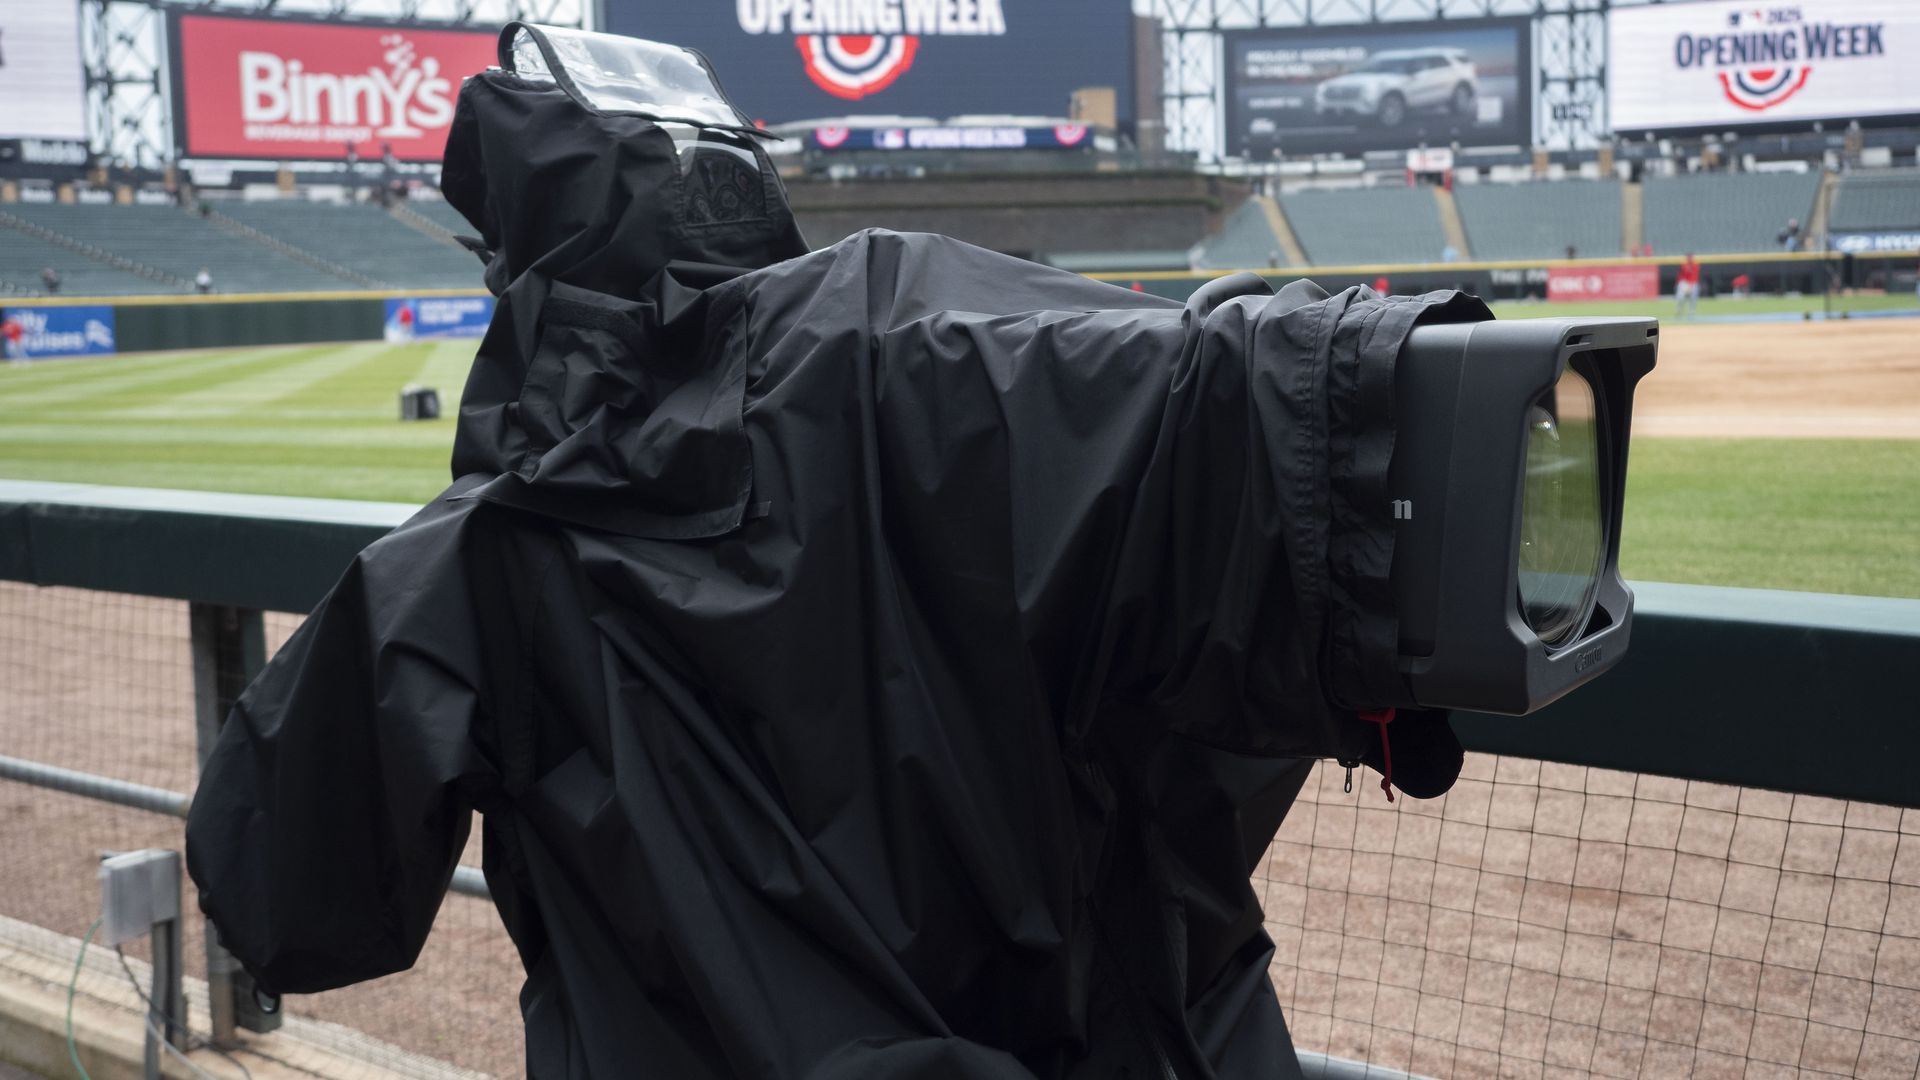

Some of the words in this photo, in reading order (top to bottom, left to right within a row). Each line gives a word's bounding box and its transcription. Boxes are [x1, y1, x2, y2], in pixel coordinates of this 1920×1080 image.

[736, 0, 901, 34] OPENING
[902, 0, 1006, 35] WEEK
[1676, 30, 1797, 68] OPENING
[1803, 23, 1885, 58] WEEK
